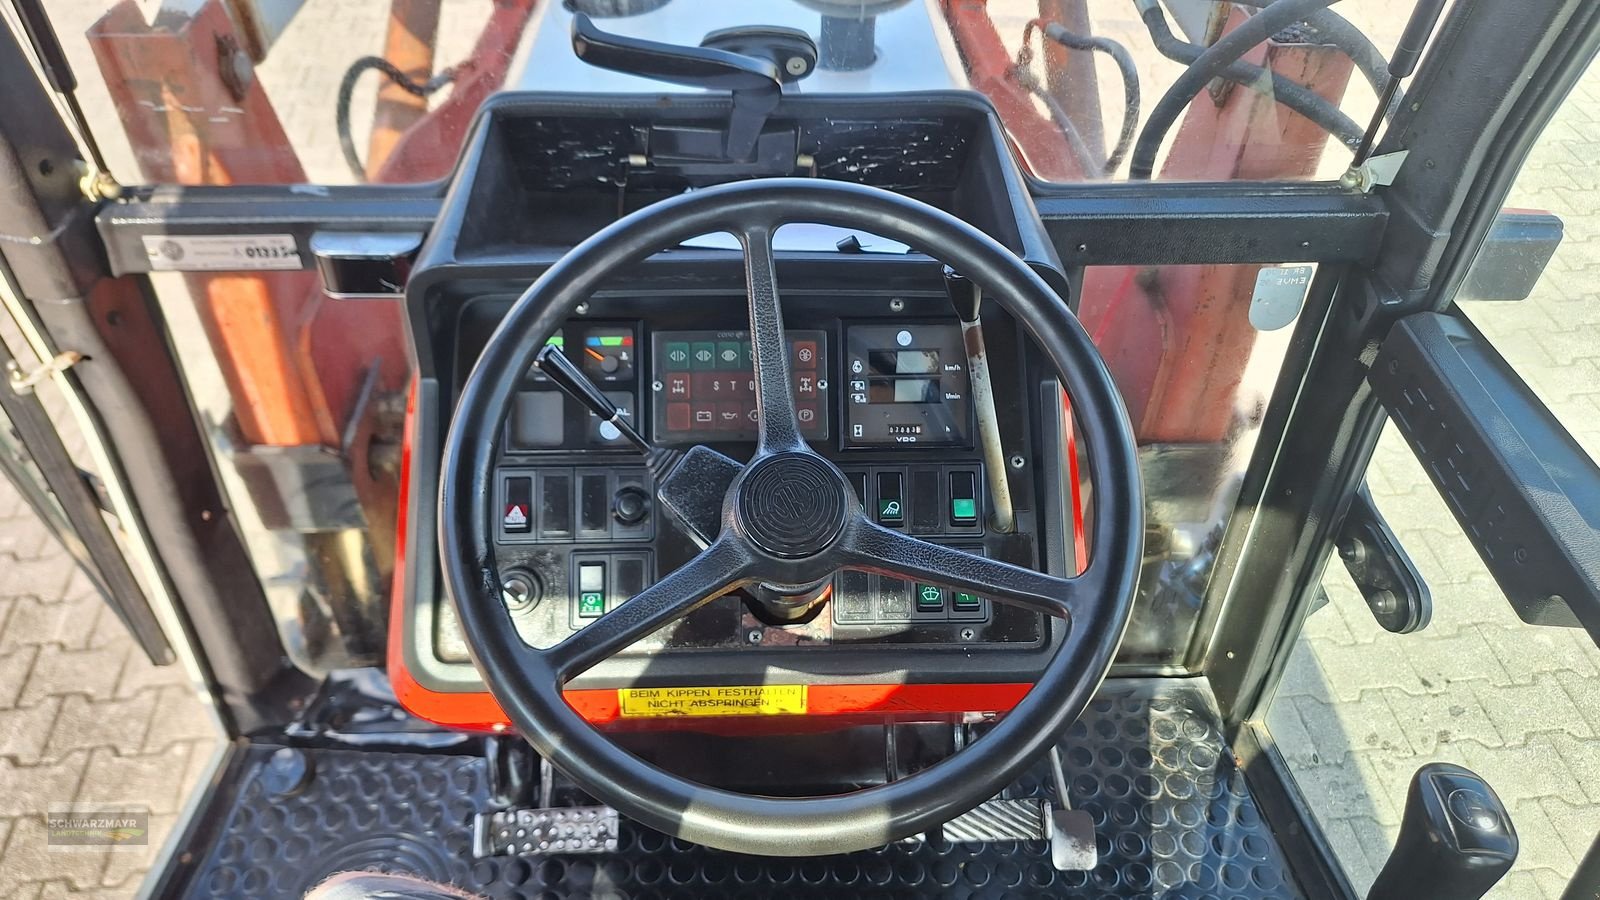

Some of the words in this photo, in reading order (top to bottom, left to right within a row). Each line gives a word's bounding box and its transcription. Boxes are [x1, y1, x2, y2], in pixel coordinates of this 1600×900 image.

[713, 381, 755, 391] STO
[630, 690, 660, 698] BEIM
[667, 689, 711, 697] KIPPEN
[717, 688, 796, 696] FESTHALTEN
[648, 699, 685, 708] NICHT
[690, 698, 769, 707] ABSPRINGEN
